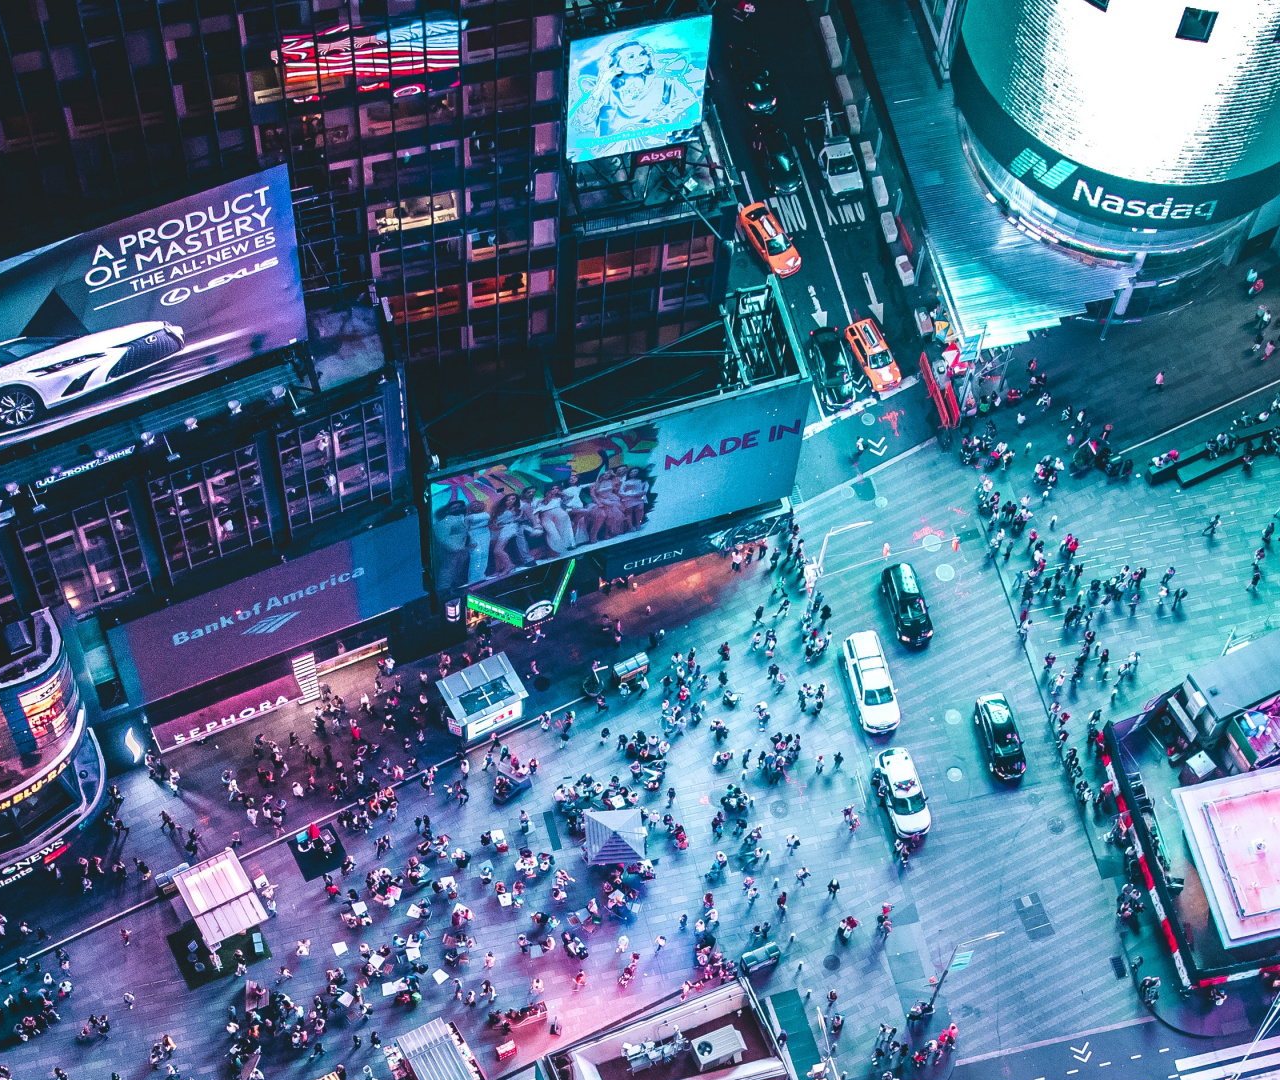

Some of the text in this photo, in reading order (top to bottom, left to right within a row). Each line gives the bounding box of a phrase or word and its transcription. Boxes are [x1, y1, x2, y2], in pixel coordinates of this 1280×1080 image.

[640, 149, 682, 163] Absen
[1072, 178, 1218, 221] Nasdaq
[85, 206, 272, 286] OF MASTERY
[92, 186, 269, 265] A PRODUCT
[129, 232, 276, 292] THE ALL-NEW ES
[193, 256, 279, 293] LEXUS
[665, 419, 802, 470] MADE IN
[623, 548, 684, 570] CITIZEN
[172, 567, 365, 646] Bank of America
[173, 695, 288, 744] SEPHORA
[15, 838, 65, 871] NEWS
